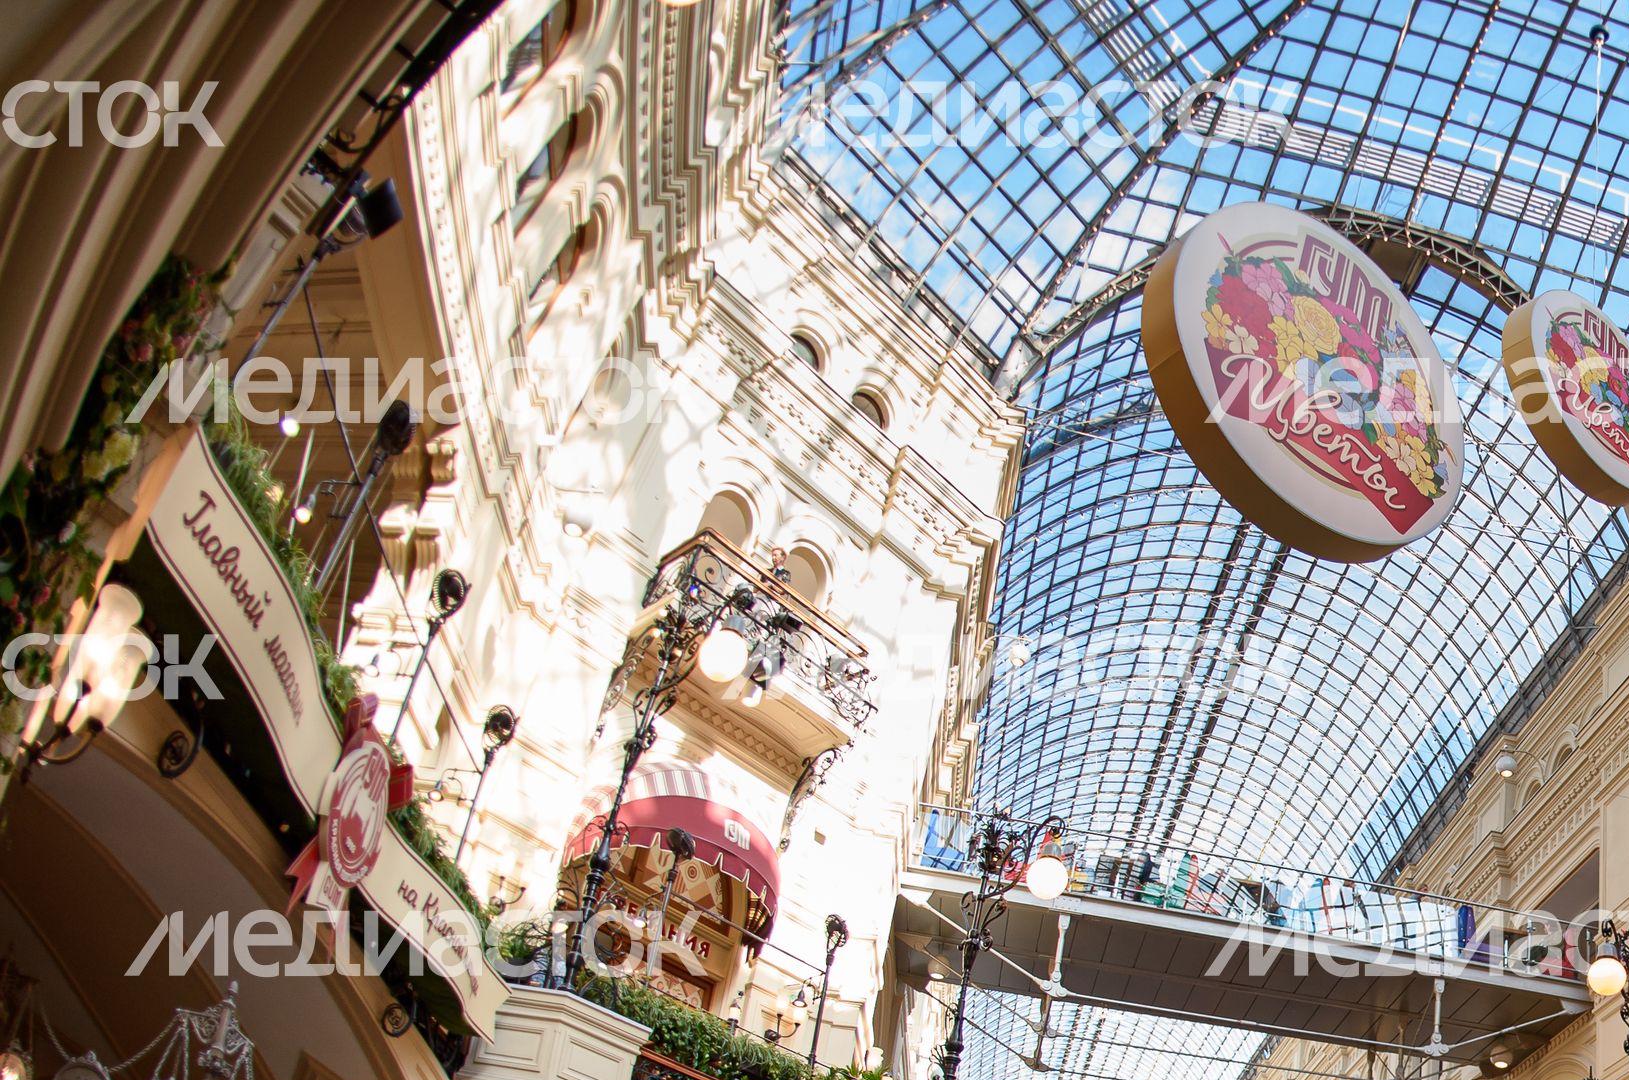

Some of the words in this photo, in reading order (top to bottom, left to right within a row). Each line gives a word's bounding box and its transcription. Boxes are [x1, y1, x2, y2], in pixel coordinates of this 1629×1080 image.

[1297, 233, 1394, 341] ГУМ
[1220, 353, 1406, 511] Цветы
[182, 488, 272, 630] Главный
[724, 818, 751, 850] ГУМ
[398, 880, 418, 908] на
